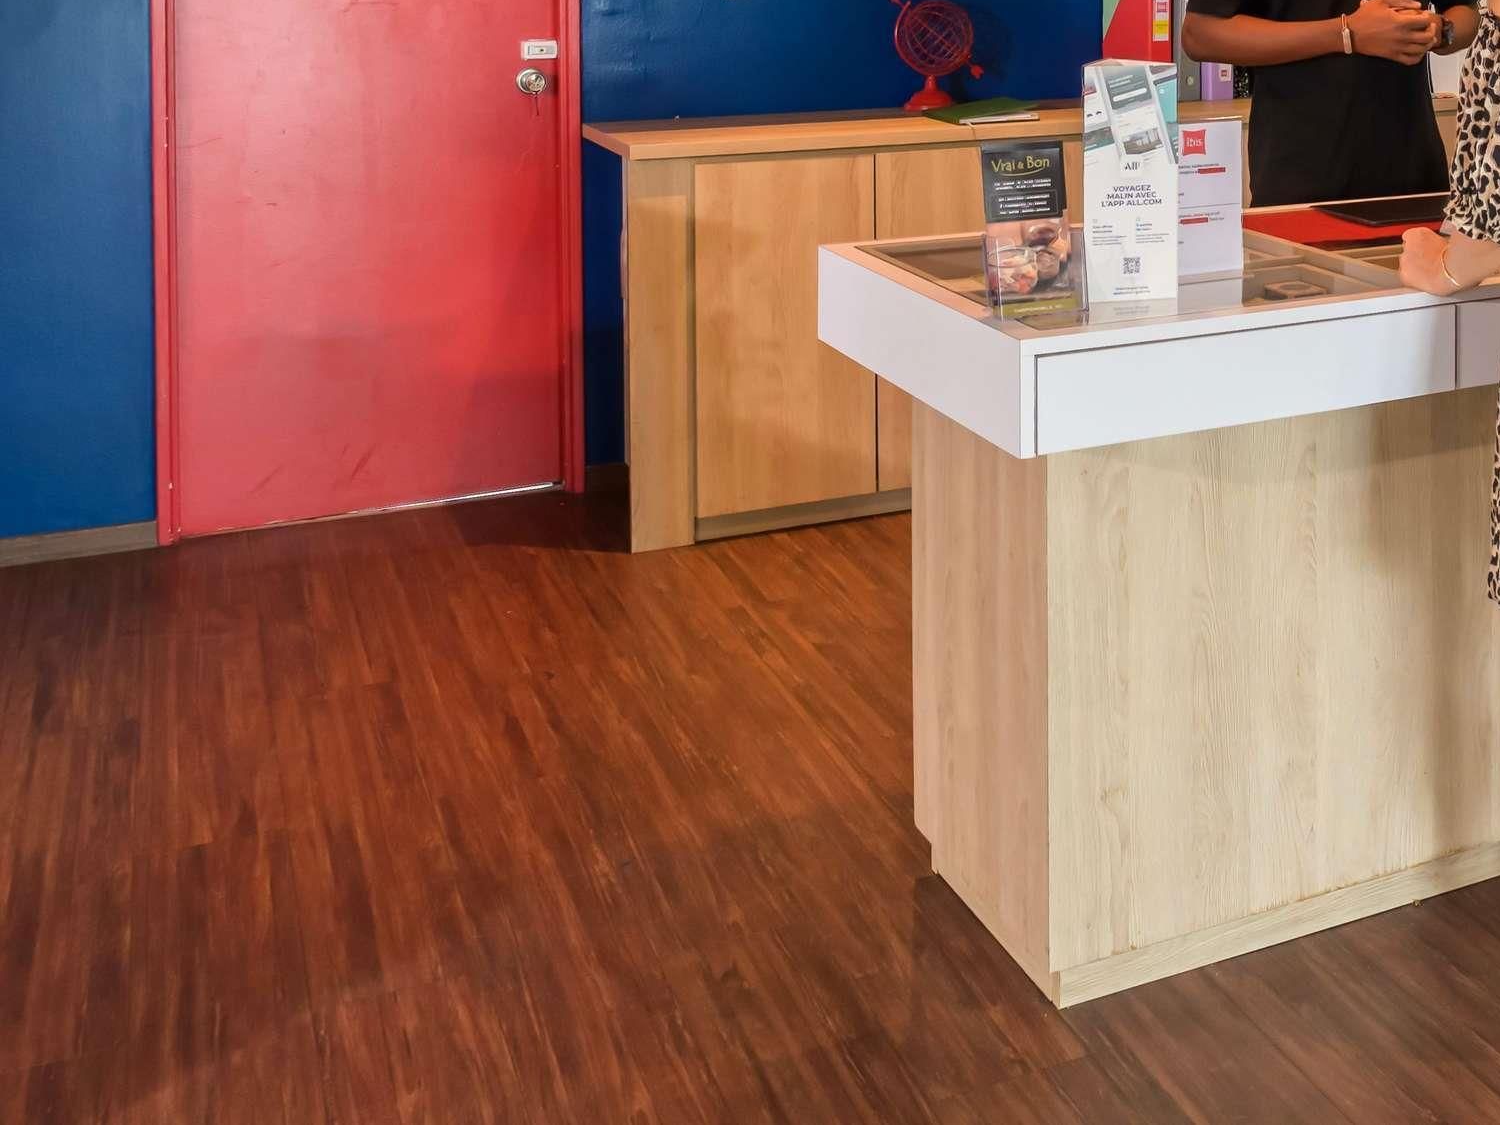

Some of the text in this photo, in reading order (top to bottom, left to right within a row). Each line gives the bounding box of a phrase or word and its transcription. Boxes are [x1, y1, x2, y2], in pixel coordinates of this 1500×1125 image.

[1186, 137, 1203, 147] ibis
[991, 158, 1015, 173] Vrai
[1026, 155, 1050, 170] Bon
[1113, 184, 1152, 193] VOYAGEZ
[1106, 191, 1157, 201] MALIN AVEC
[1101, 198, 1162, 208] L'APP ALL.COM
